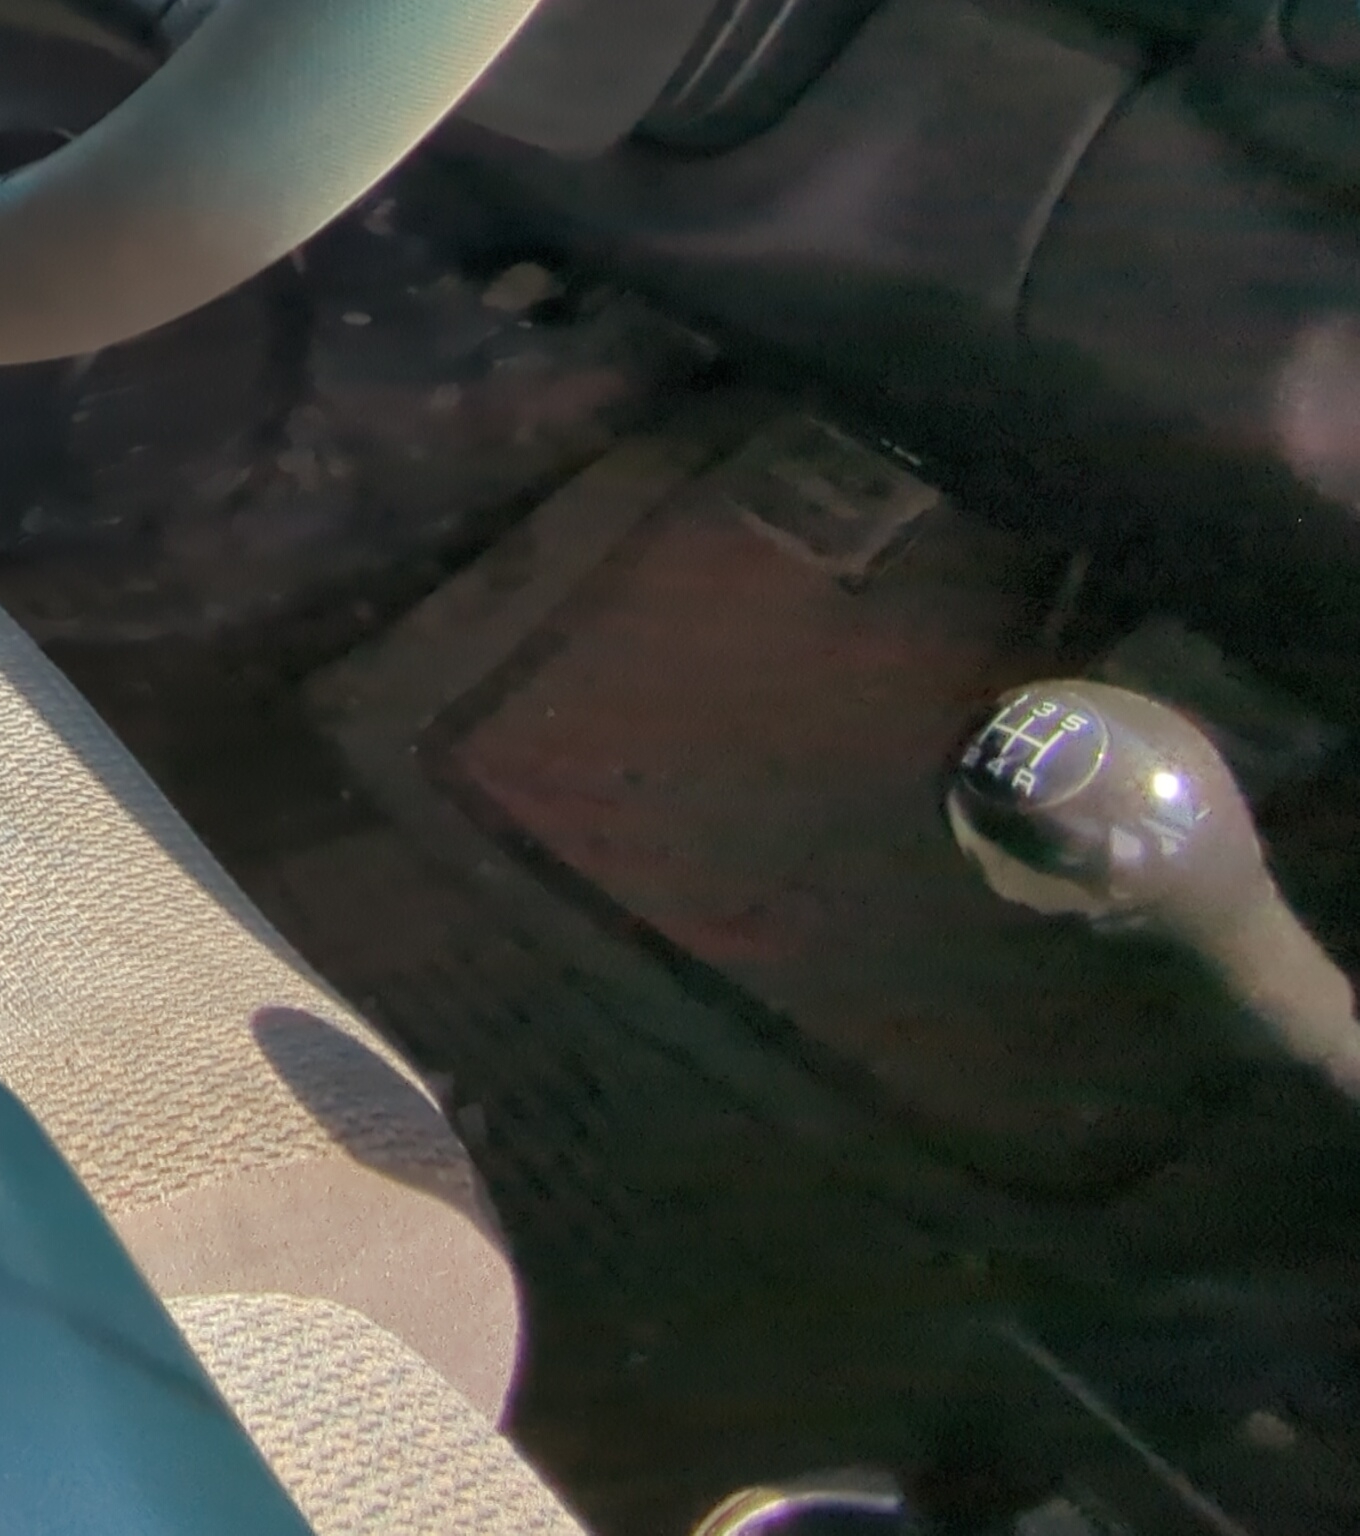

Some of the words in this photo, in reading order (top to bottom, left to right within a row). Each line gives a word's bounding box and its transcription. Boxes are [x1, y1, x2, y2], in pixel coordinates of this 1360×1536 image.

[1032, 701, 1057, 717] 3
[1060, 713, 1089, 732] 5
[986, 757, 1006, 779] 4
[1011, 768, 1036, 798] R
